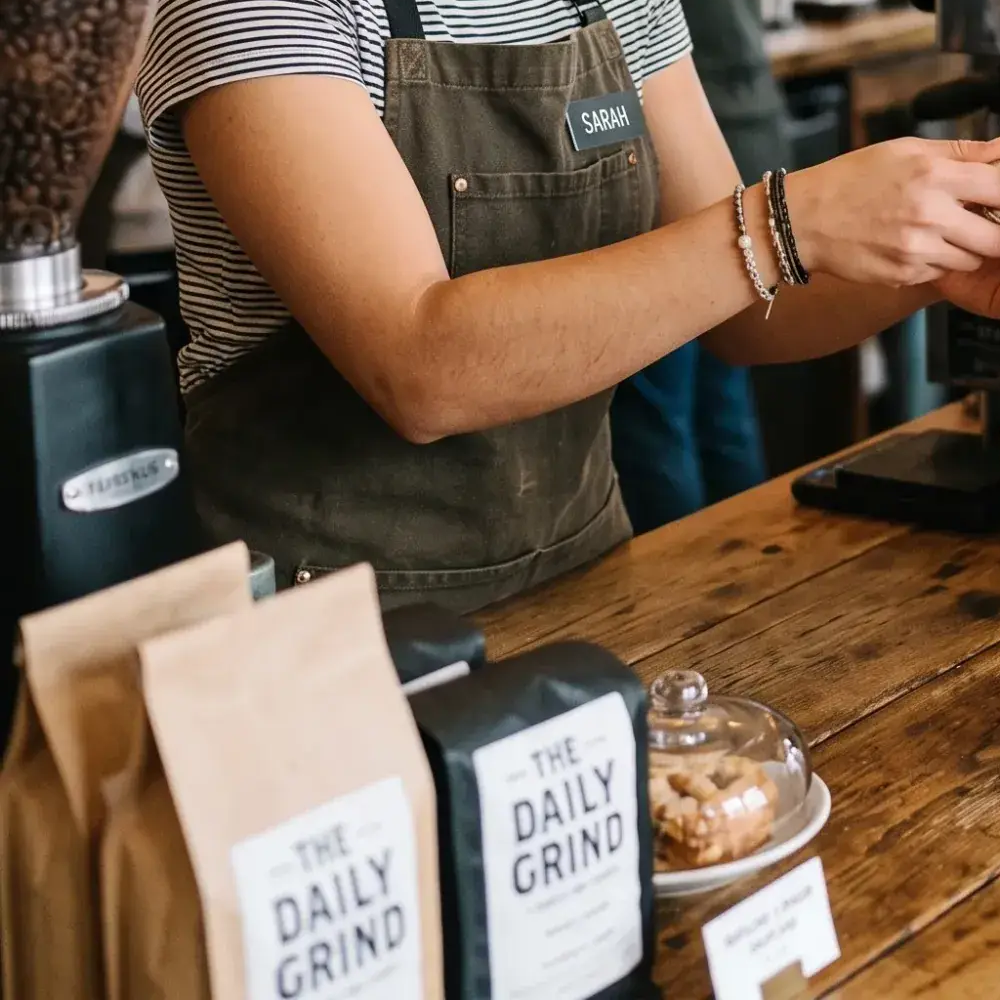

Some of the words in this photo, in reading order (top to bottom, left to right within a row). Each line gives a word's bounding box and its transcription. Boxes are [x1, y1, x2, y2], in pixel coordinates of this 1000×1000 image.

[581, 105, 630, 134] SARAH
[530, 737, 581, 777] THE
[512, 759, 615, 842] DAILY
[291, 821, 349, 873] THE
[511, 811, 624, 895] GRIND
[274, 847, 395, 946] DAILY
[275, 904, 406, 1000] GRIND
